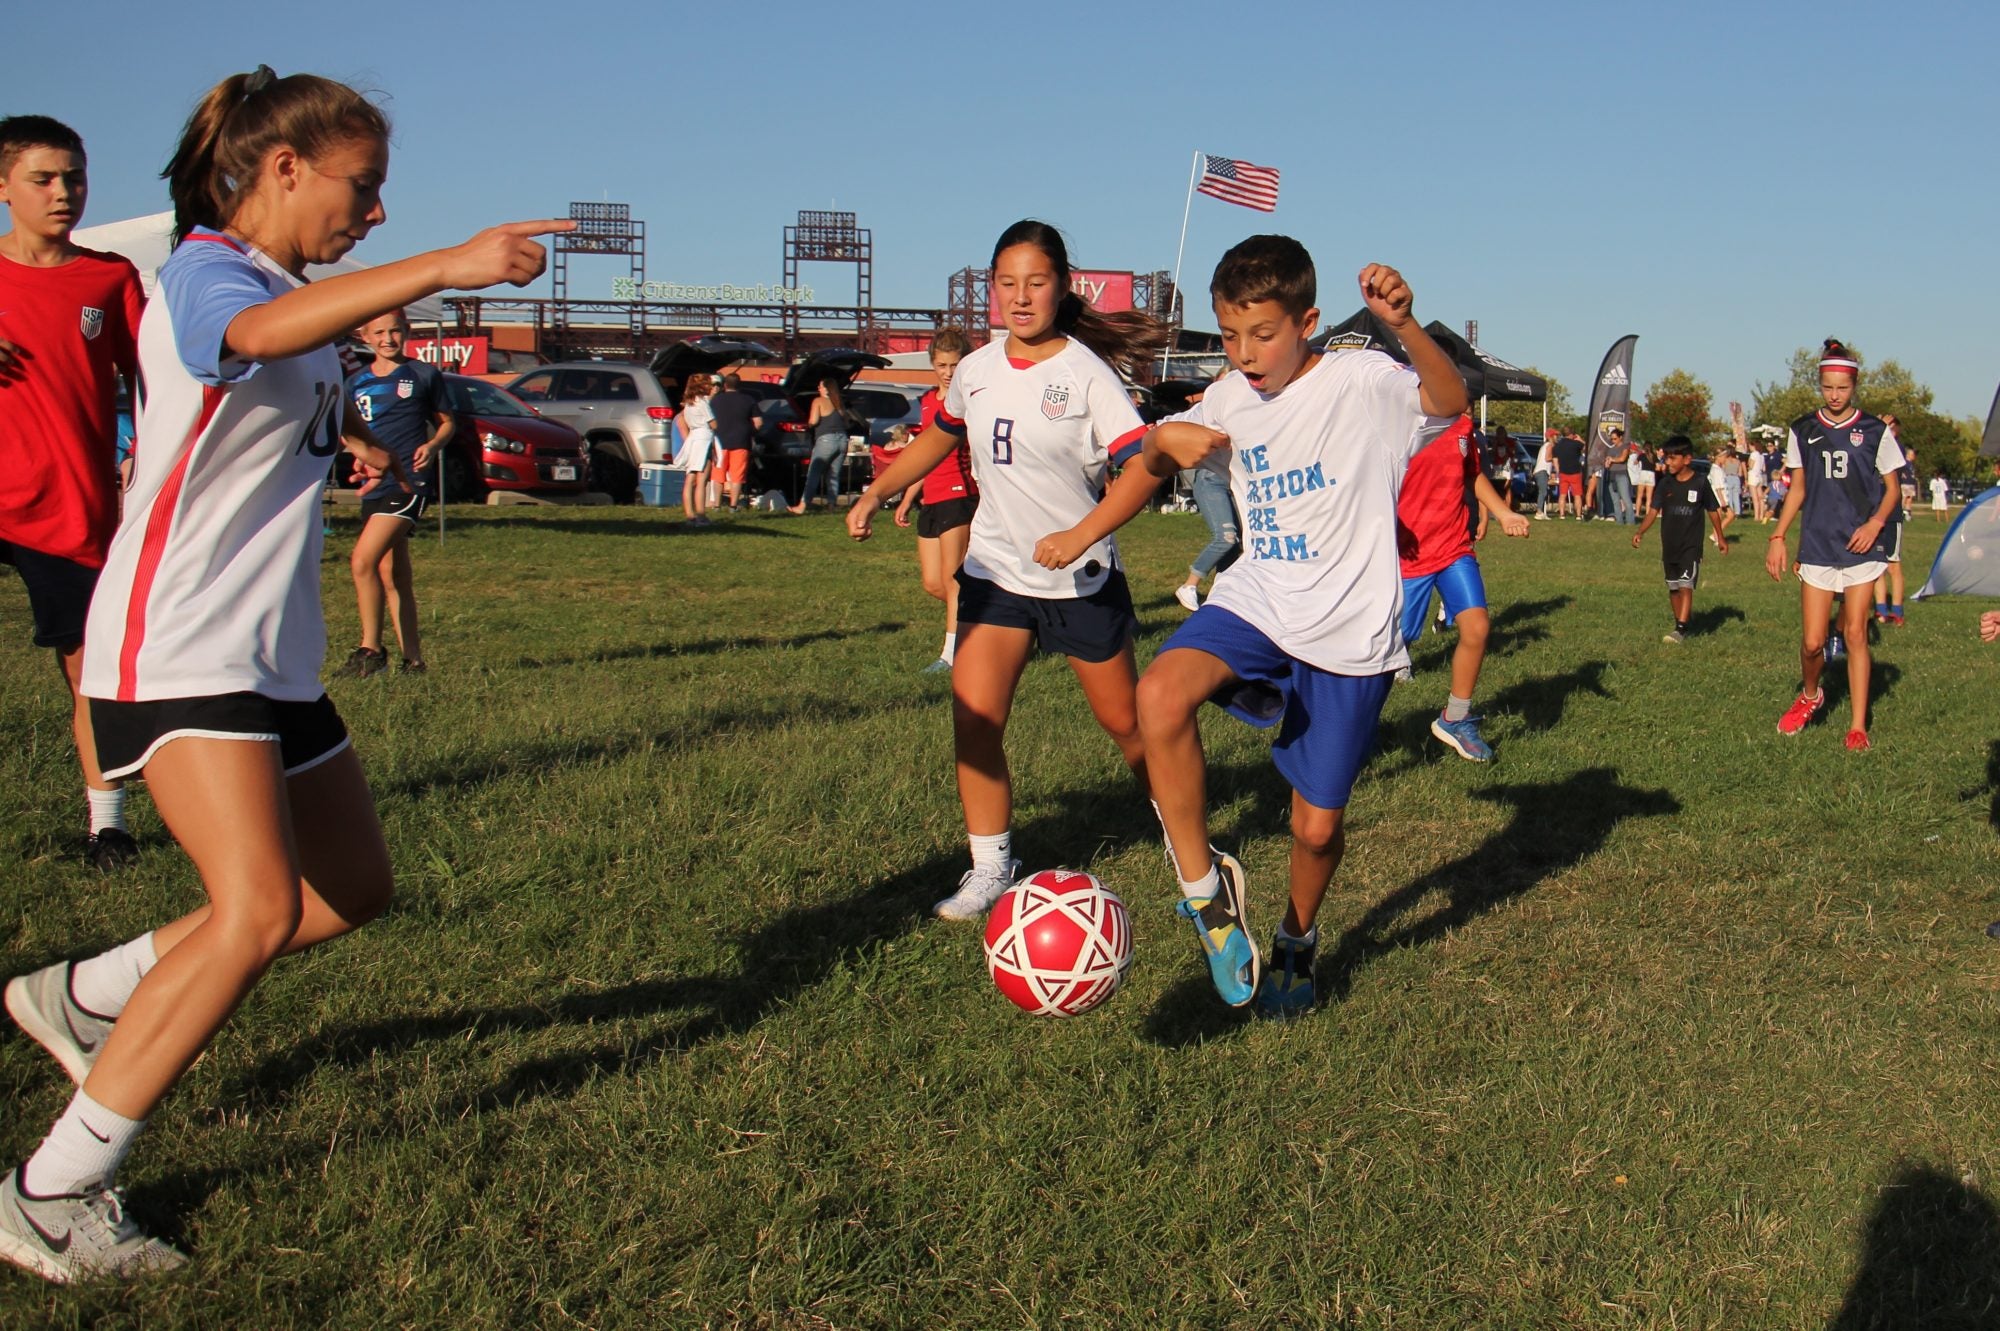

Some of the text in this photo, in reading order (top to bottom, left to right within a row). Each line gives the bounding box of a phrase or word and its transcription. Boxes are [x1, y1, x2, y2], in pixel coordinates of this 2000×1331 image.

[641, 281, 815, 302] Citizens Bank Park
[83, 307, 103, 322] USA
[1046, 391, 1067, 404] USA
[295, 381, 340, 457] 10
[992, 417, 1015, 465] 8
[1240, 444, 1270, 474] NE
[1822, 450, 1849, 479] 13
[1246, 461, 1337, 503] ATION.
